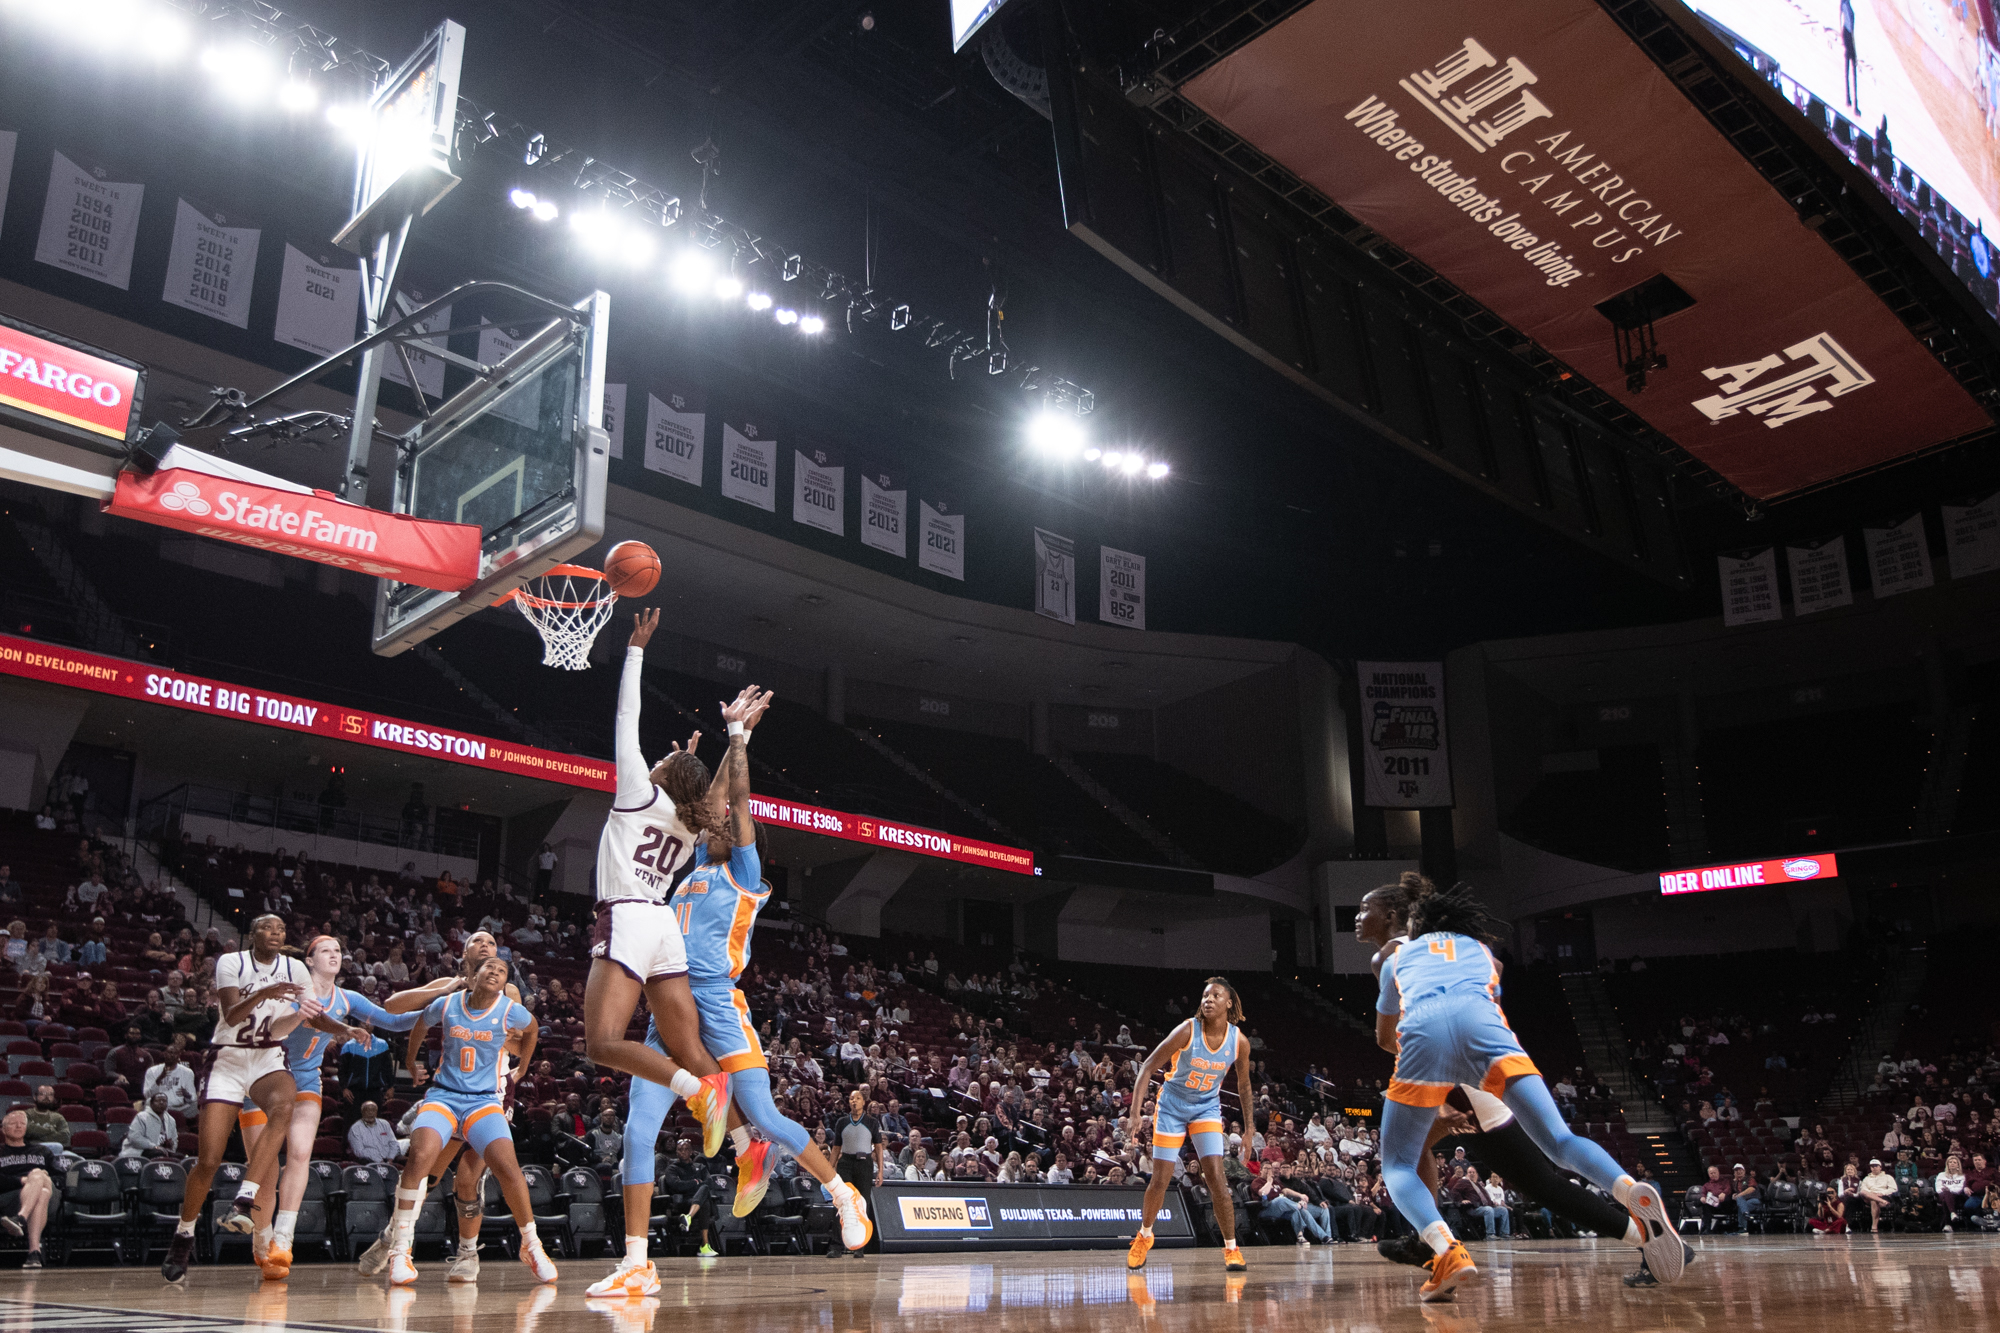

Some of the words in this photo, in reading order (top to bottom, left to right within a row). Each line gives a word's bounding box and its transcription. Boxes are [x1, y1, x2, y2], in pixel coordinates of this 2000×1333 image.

[1344, 95, 1425, 162] Where
[1410, 153, 1502, 223] students
[1488, 210, 1539, 250] love
[1523, 240, 1584, 288] living.
[1536, 130, 1684, 246] AMERICAN
[75, 192, 113, 218] 1994
[1500, 151, 1643, 263] CAMPUS
[71, 208, 112, 234] 2008
[68, 224, 109, 251] 2009
[197, 237, 233, 262] 2012
[67, 242, 104, 267] 2011
[195, 252, 232, 277] 2014
[192, 267, 228, 292] 2018
[305, 265, 332, 280] SWEET
[189, 283, 227, 308] 2019
[305, 280, 335, 302] 2021
[0, 347, 121, 408] FARGO
[655, 430, 695, 460] 2007
[730, 460, 769, 488] 2008
[803, 486, 836, 512] 2010
[868, 508, 899, 535] 2013
[927, 530, 957, 555] 2021
[1110, 569, 1136, 589] 2011
[1110, 600, 1135, 620] 852
[25, 651, 119, 682] DEVELOPMENT
[716, 655, 746, 673] 207
[1372, 672, 1428, 686] NATIONAL
[145, 673, 213, 707] SCORE
[216, 687, 251, 715] BIG
[255, 695, 318, 727] TODAY
[1365, 685, 1436, 700] CHAMPIONS
[919, 696, 950, 716] 208
[1390, 707, 1435, 724] FINAL
[1598, 706, 1632, 722] 210
[1087, 711, 1120, 729] 209
[372, 720, 487, 760] KRESSTON
[489, 747, 503, 759] BY
[502, 750, 544, 768] JOHNSON
[545, 759, 608, 781] DEVELOPMENT
[1383, 756, 1429, 776] 2011
[778, 805, 791, 822] IN
[791, 807, 812, 827] THE
[812, 812, 843, 833] $360s
[632, 826, 684, 876] 20
[878, 825, 951, 854] KRESSTON
[952, 842, 962, 853] BY
[961, 844, 989, 858] JOHNSON
[989, 847, 1031, 866] DEVELOPMENT
[634, 867, 664, 891] KENT
[1034, 866, 1043, 877] CC
[1701, 864, 1765, 890] ONLINE
[1785, 864, 1819, 874] GRINGOS
[676, 901, 693, 936] 11
[1428, 938, 1458, 963] 4
[235, 1013, 273, 1044] 24
[302, 1036, 320, 1060] 1
[460, 1046, 477, 1073] 0
[1184, 1069, 1218, 1092] 55
[0, 1154, 27, 1168] TEXAS
[913, 1206, 964, 1221] MUSTANG
[968, 1205, 987, 1221] CAT
[1000, 1208, 1045, 1222] BUILDING
[1126, 1208, 1143, 1221] THE
